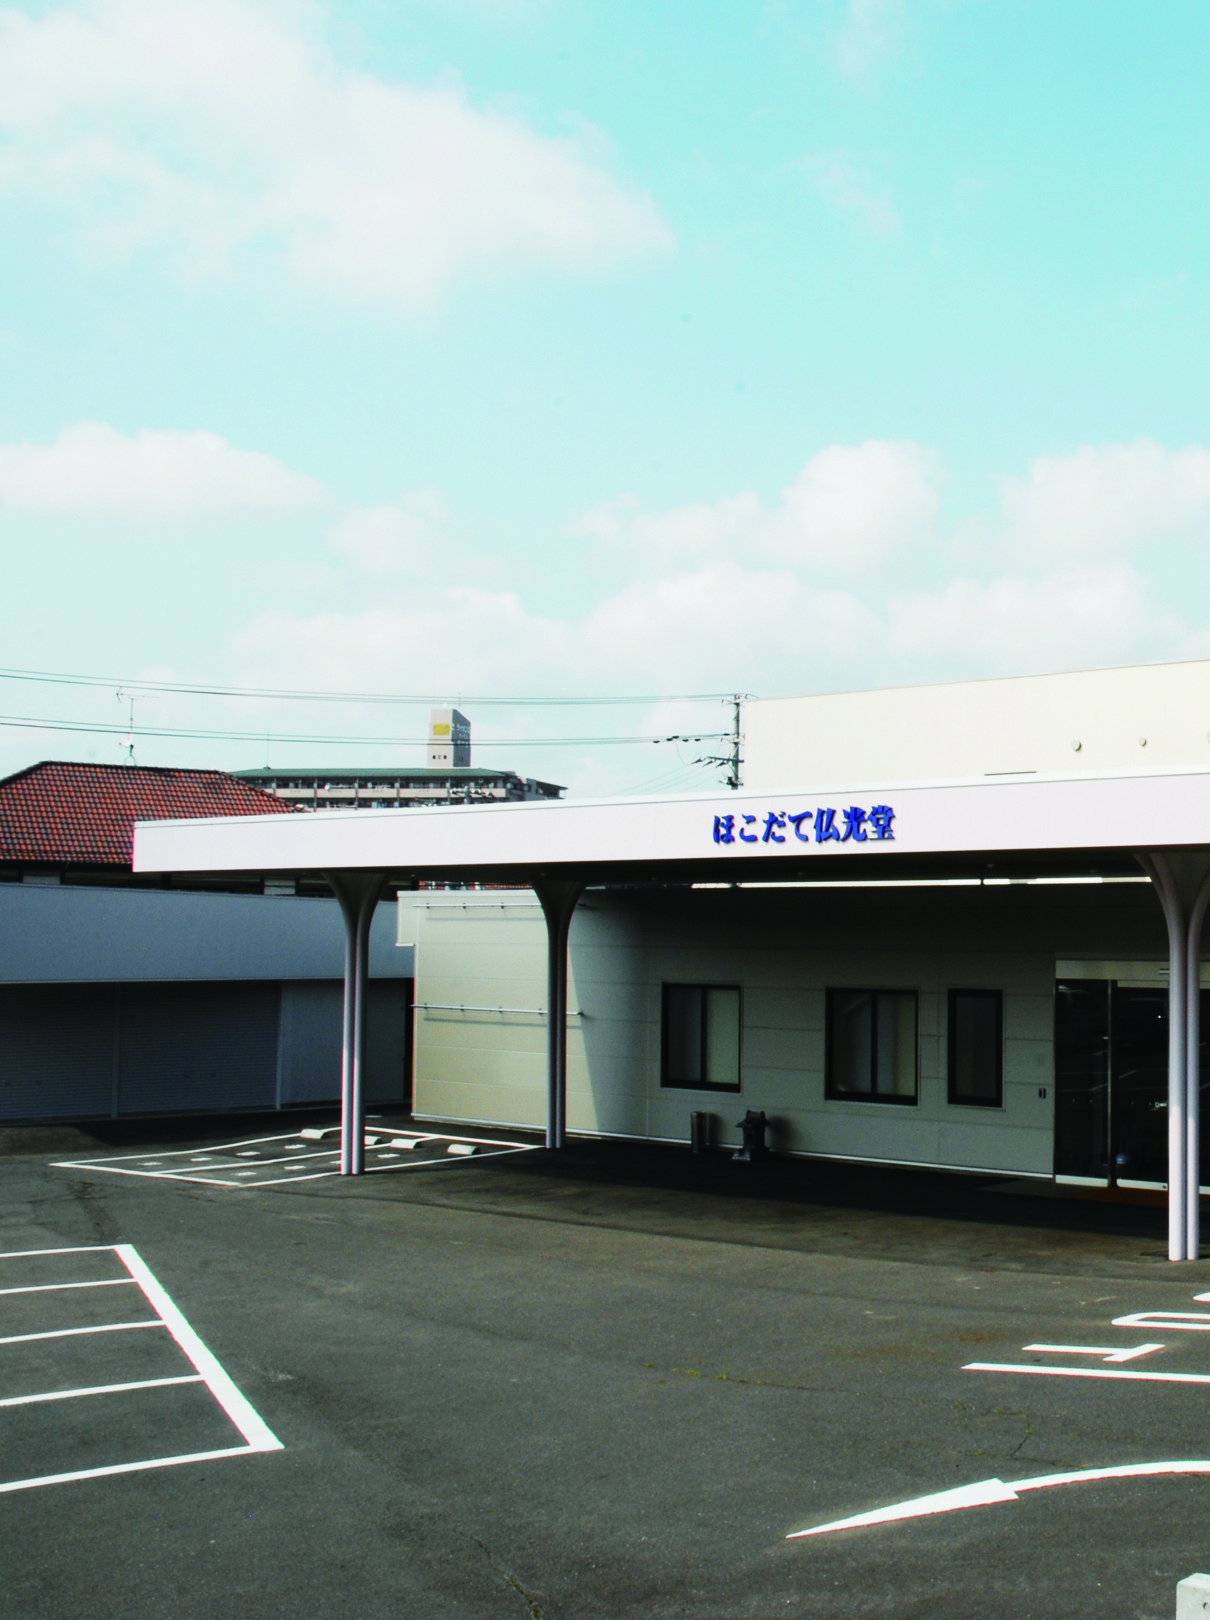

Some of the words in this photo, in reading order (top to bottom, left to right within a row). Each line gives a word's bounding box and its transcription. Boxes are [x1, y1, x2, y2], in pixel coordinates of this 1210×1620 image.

[713, 804, 896, 844] ほこだて仏光堂
